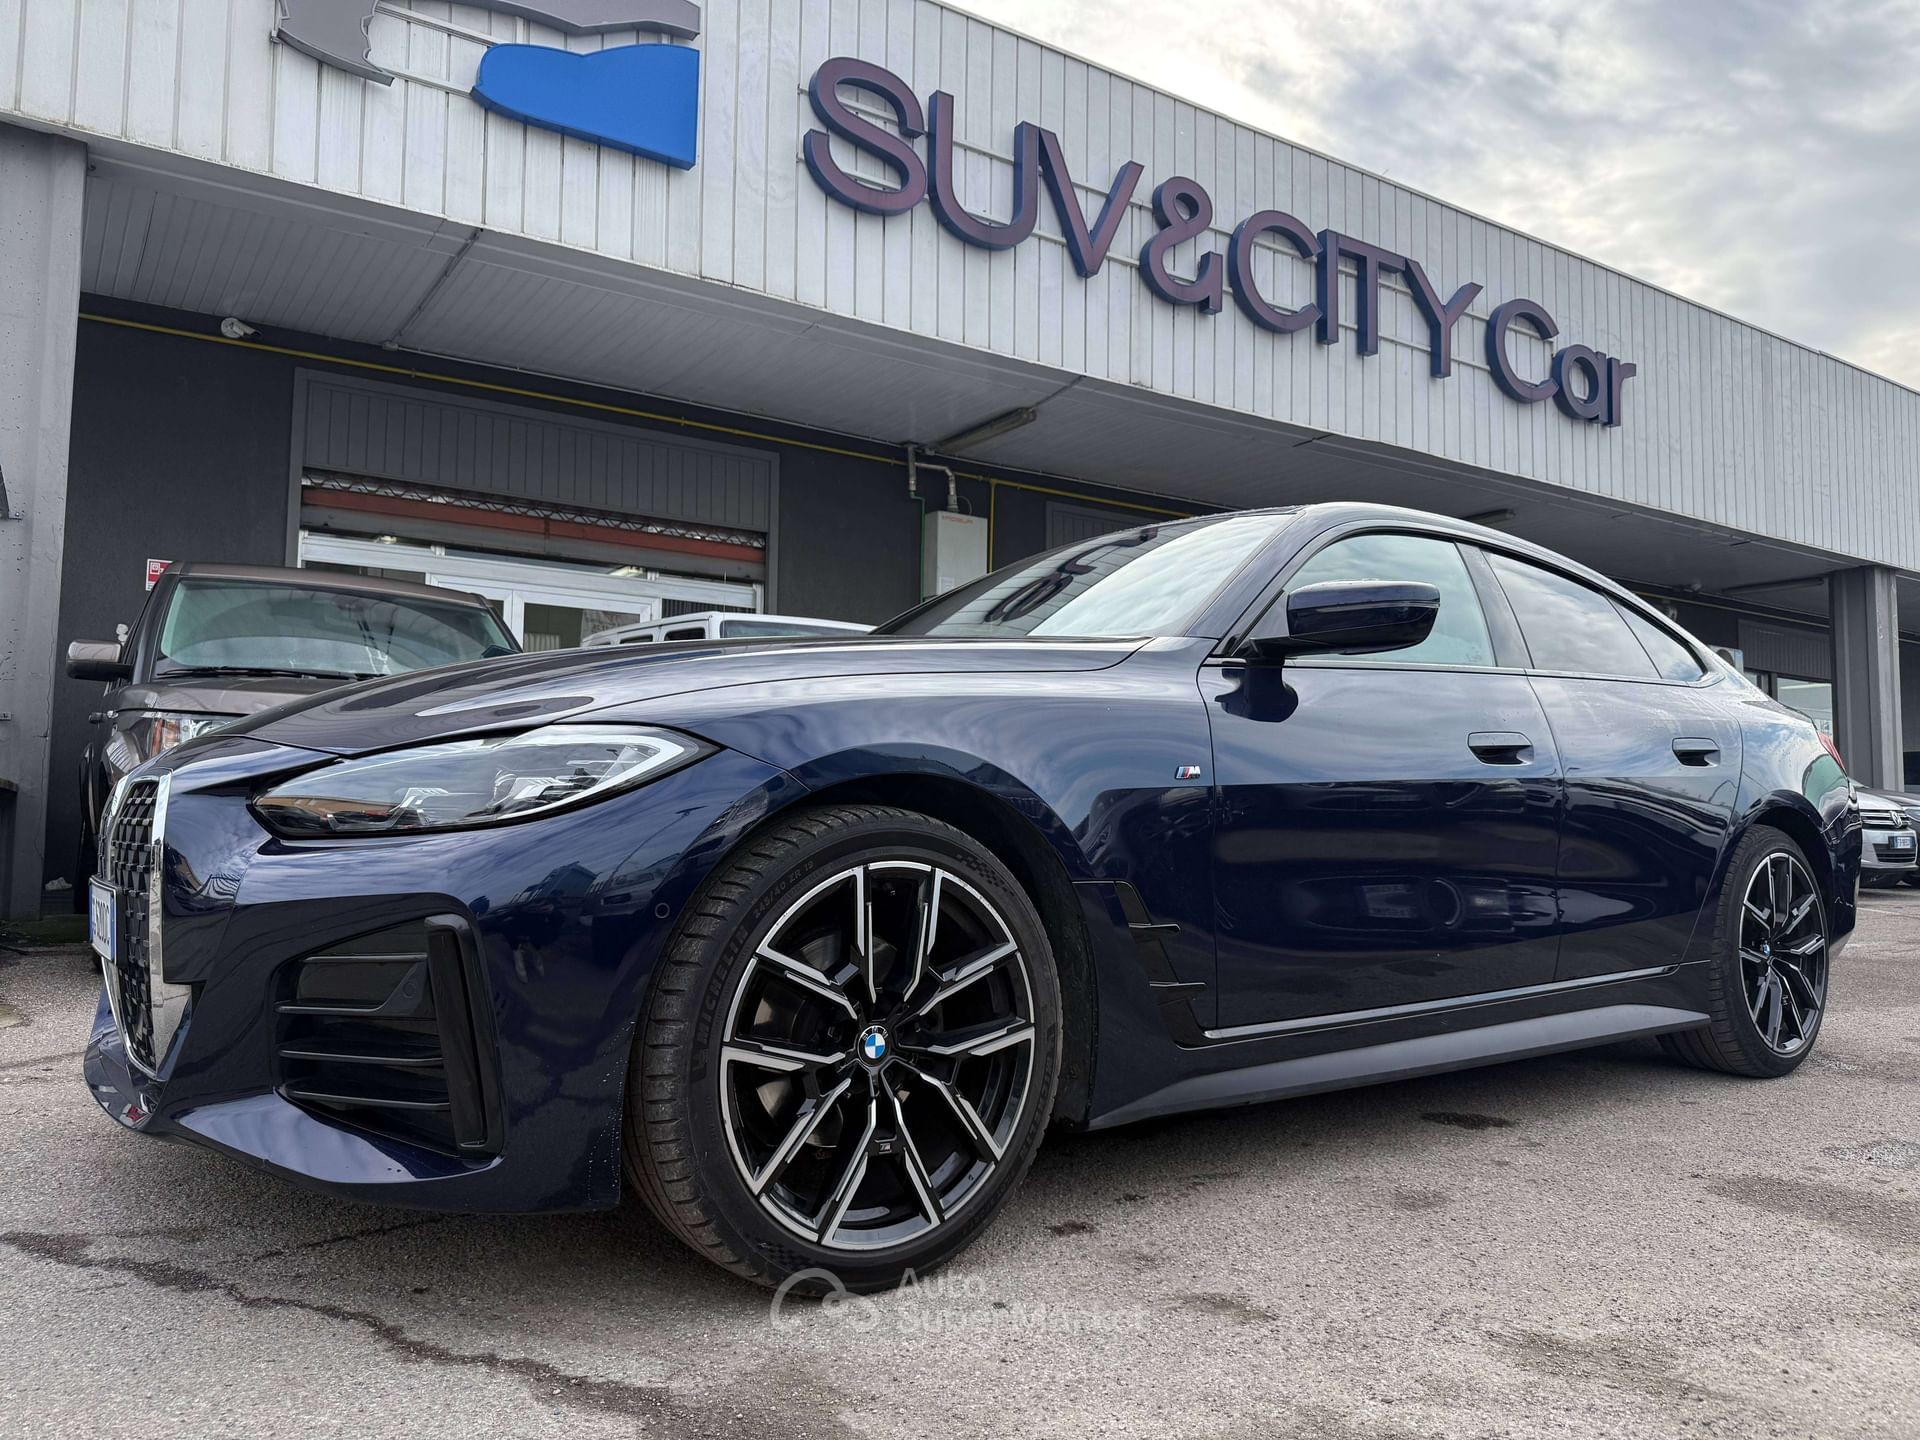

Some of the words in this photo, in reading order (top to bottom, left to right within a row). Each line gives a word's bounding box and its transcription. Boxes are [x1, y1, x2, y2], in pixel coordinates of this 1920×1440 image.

[1484, 298, 1637, 429] Car
[695, 923, 750, 1048] MICHELIN
[861, 1026, 889, 1041] BMW
